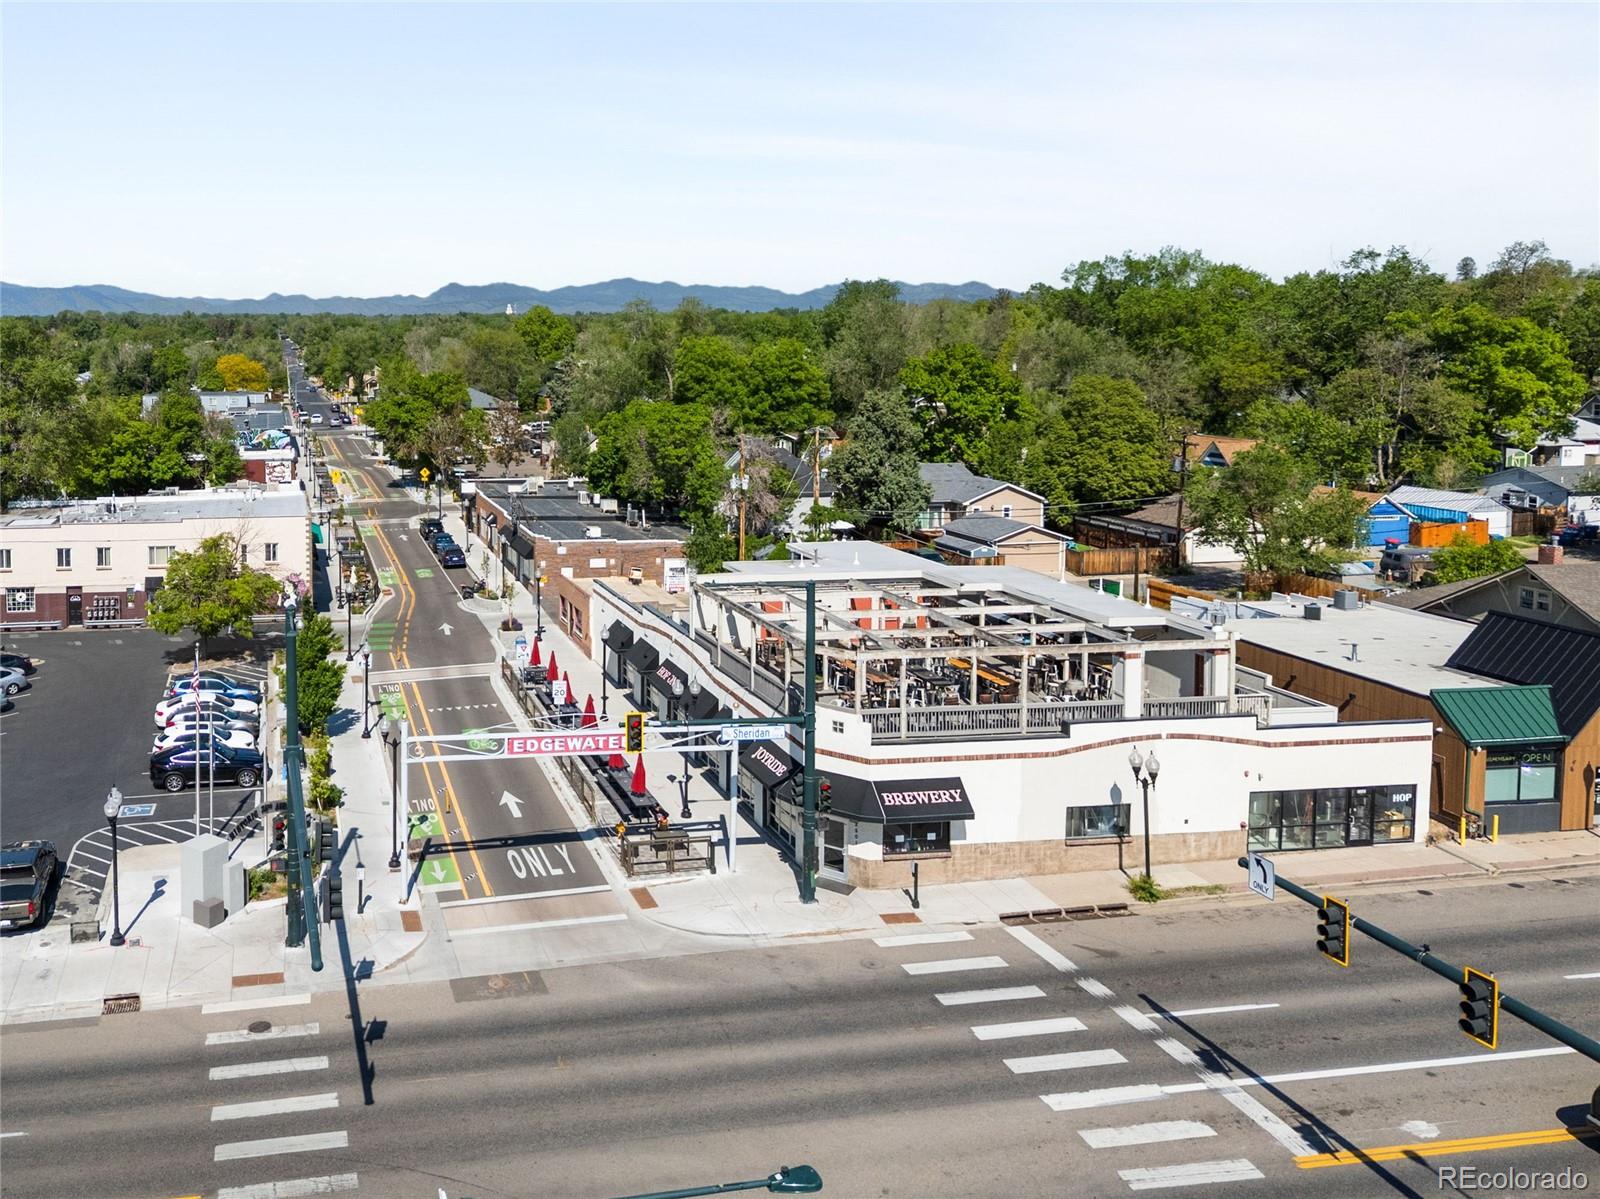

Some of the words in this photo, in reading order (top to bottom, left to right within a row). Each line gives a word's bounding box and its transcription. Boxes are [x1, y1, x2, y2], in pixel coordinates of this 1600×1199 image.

[733, 728, 770, 739] Sheridan
[751, 746, 788, 777] JOYRIDE
[1522, 753, 1551, 762] OPEN
[881, 788, 962, 806] BREWERY
[1392, 793, 1412, 802] HOP
[506, 844, 577, 880] ONLY
[1253, 880, 1270, 894] ONLY
